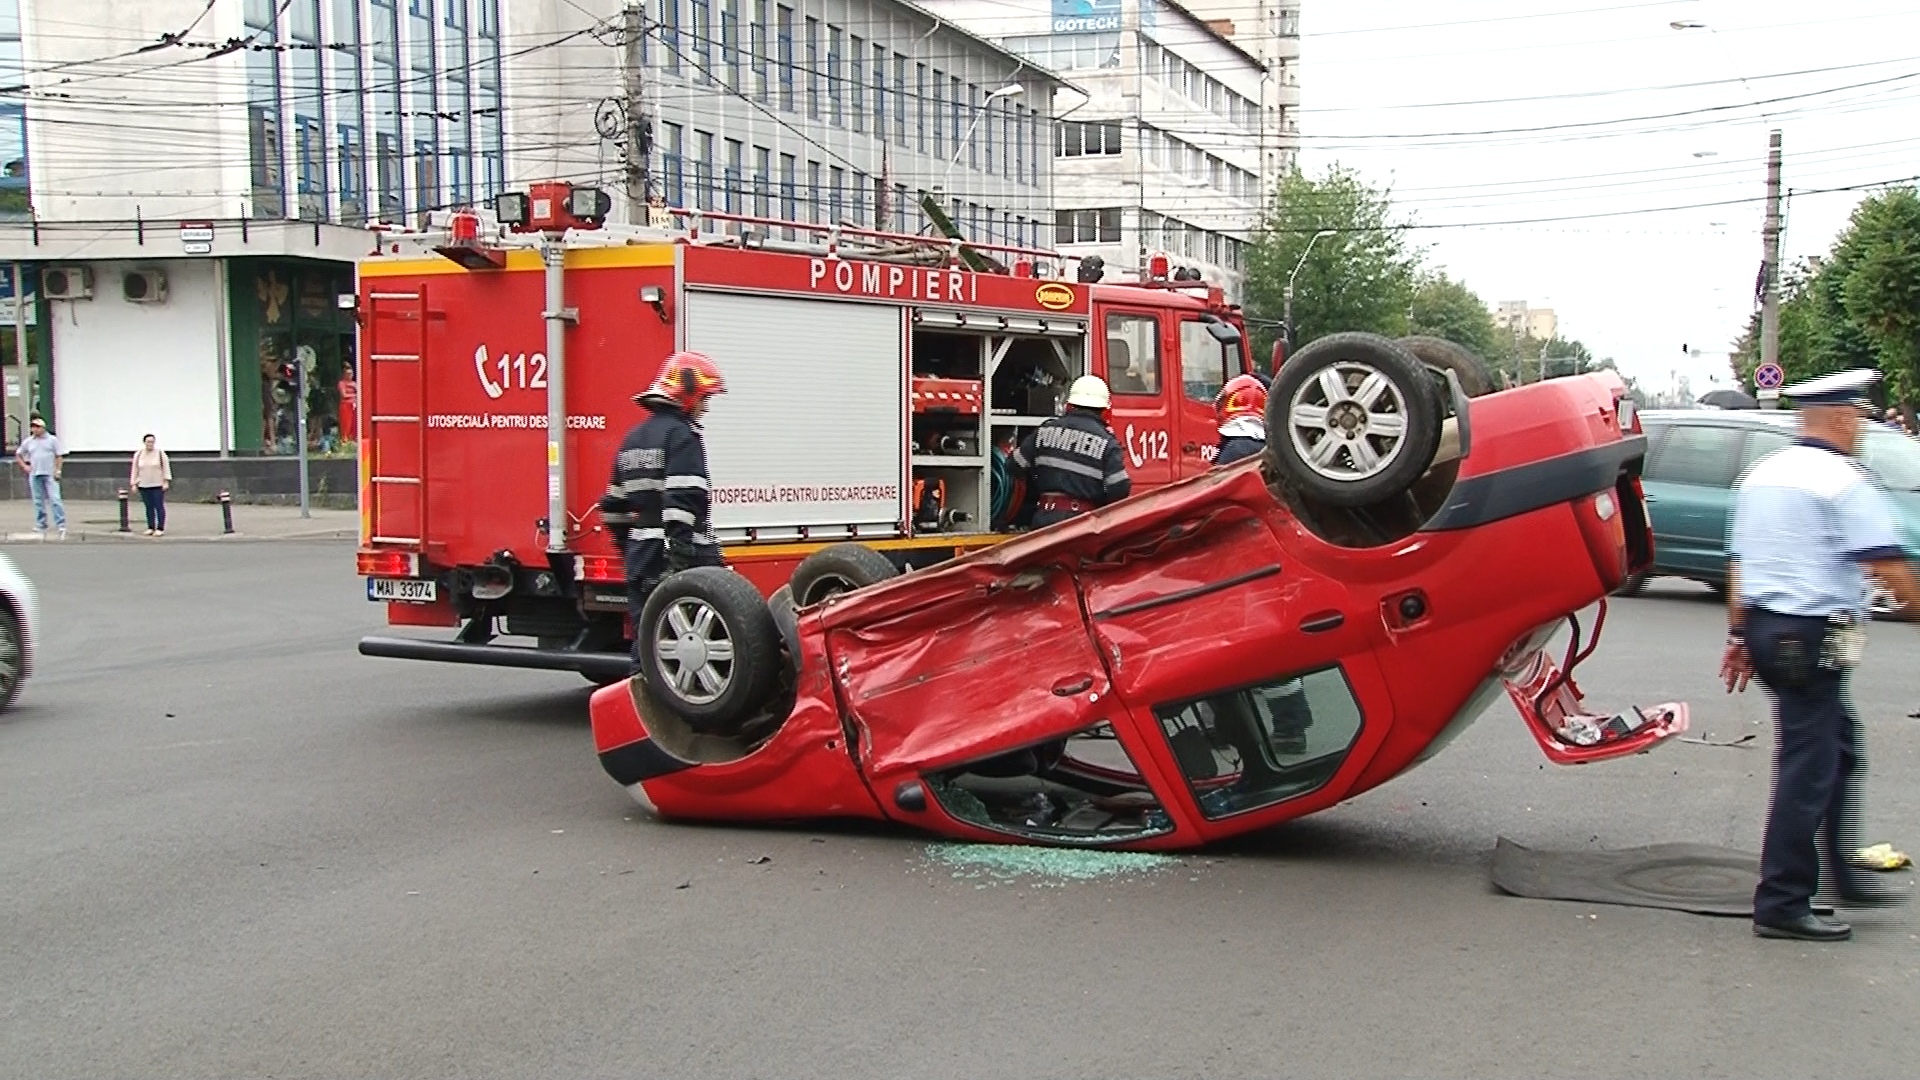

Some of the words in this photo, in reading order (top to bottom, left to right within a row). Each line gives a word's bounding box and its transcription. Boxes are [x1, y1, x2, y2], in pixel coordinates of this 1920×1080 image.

[1054, 16, 1118, 31] GOTECH
[810, 258, 977, 301] POMPIERI
[497, 353, 547, 388] 112
[427, 412, 489, 428] UTOSPECIALĂ
[491, 415, 528, 428] PENTRU
[1036, 426, 1109, 460] POMPIERI
[1139, 431, 1168, 459] 112
[779, 487, 819, 502] PENTRU
[821, 486, 897, 501] DESCARCERARE
[376, 581, 394, 595] MAI
[400, 582, 432, 597] 33174
